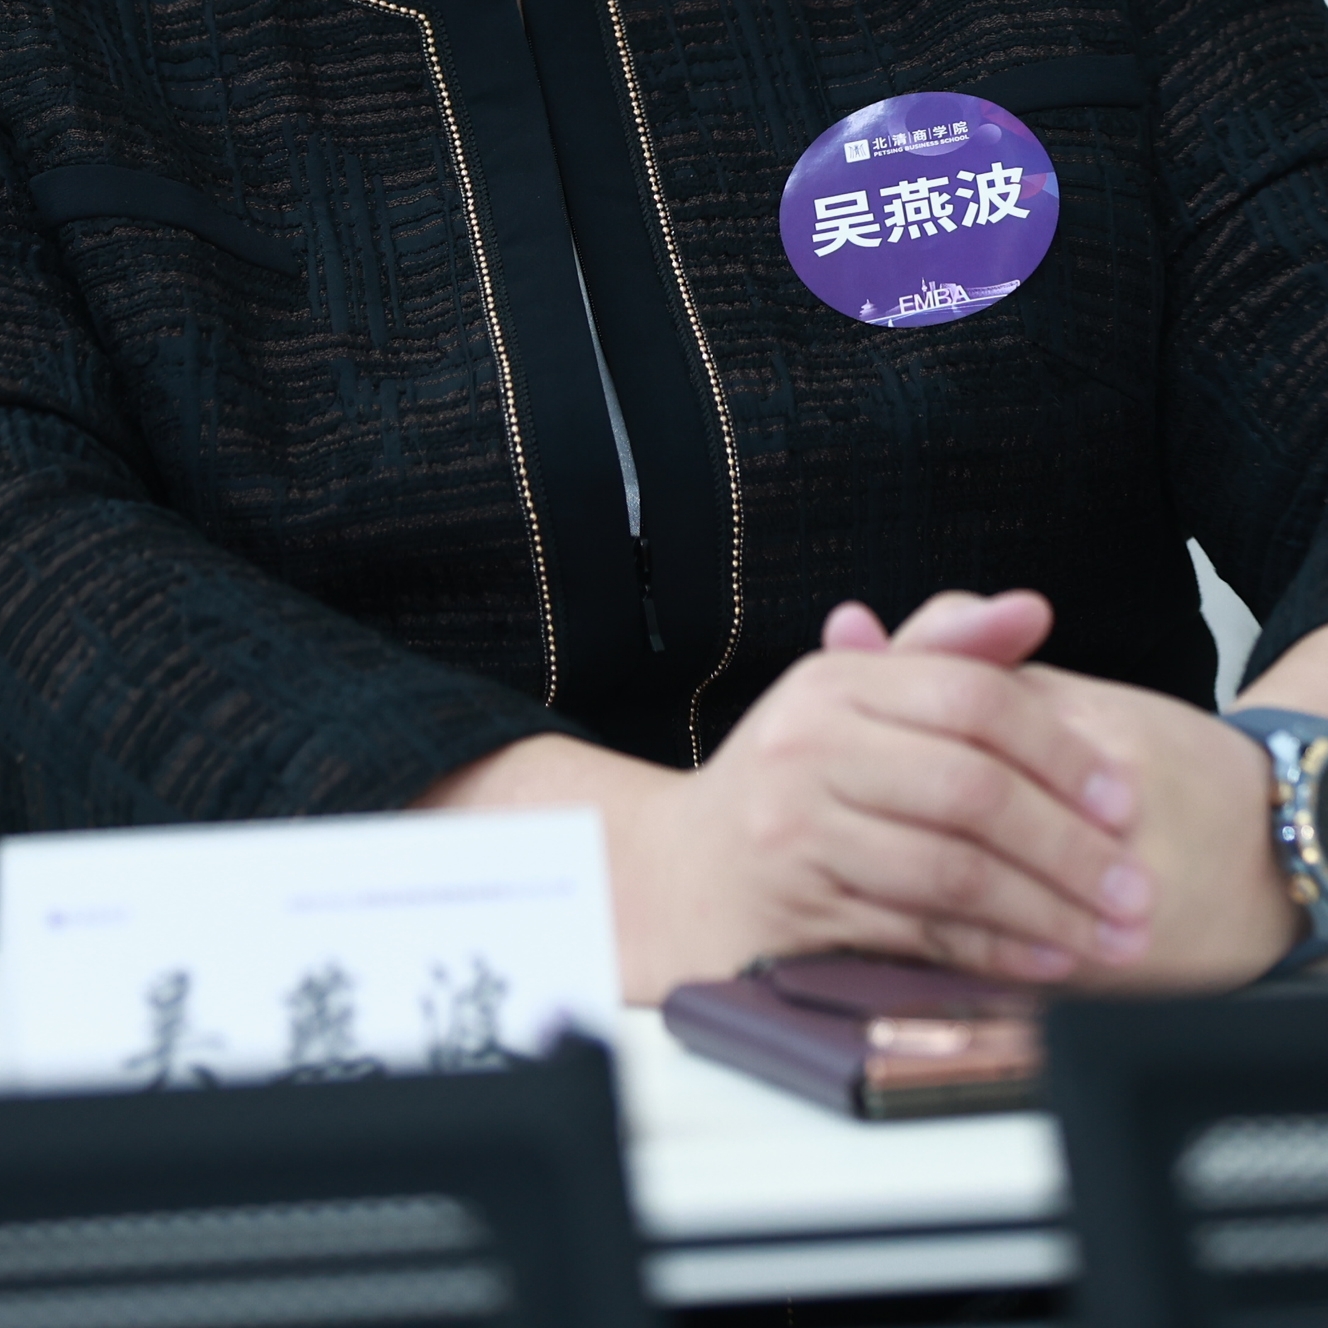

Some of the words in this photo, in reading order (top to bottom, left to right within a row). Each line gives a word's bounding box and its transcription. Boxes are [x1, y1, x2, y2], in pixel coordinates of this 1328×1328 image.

[872, 120, 969, 150] 北清商学院
[873, 146, 904, 157] PETSING
[904, 140, 939, 152] BUSINESS
[940, 134, 970, 145] SCHOOL
[812, 162, 1031, 257] 吴燕波
[898, 285, 971, 315] EMBA
